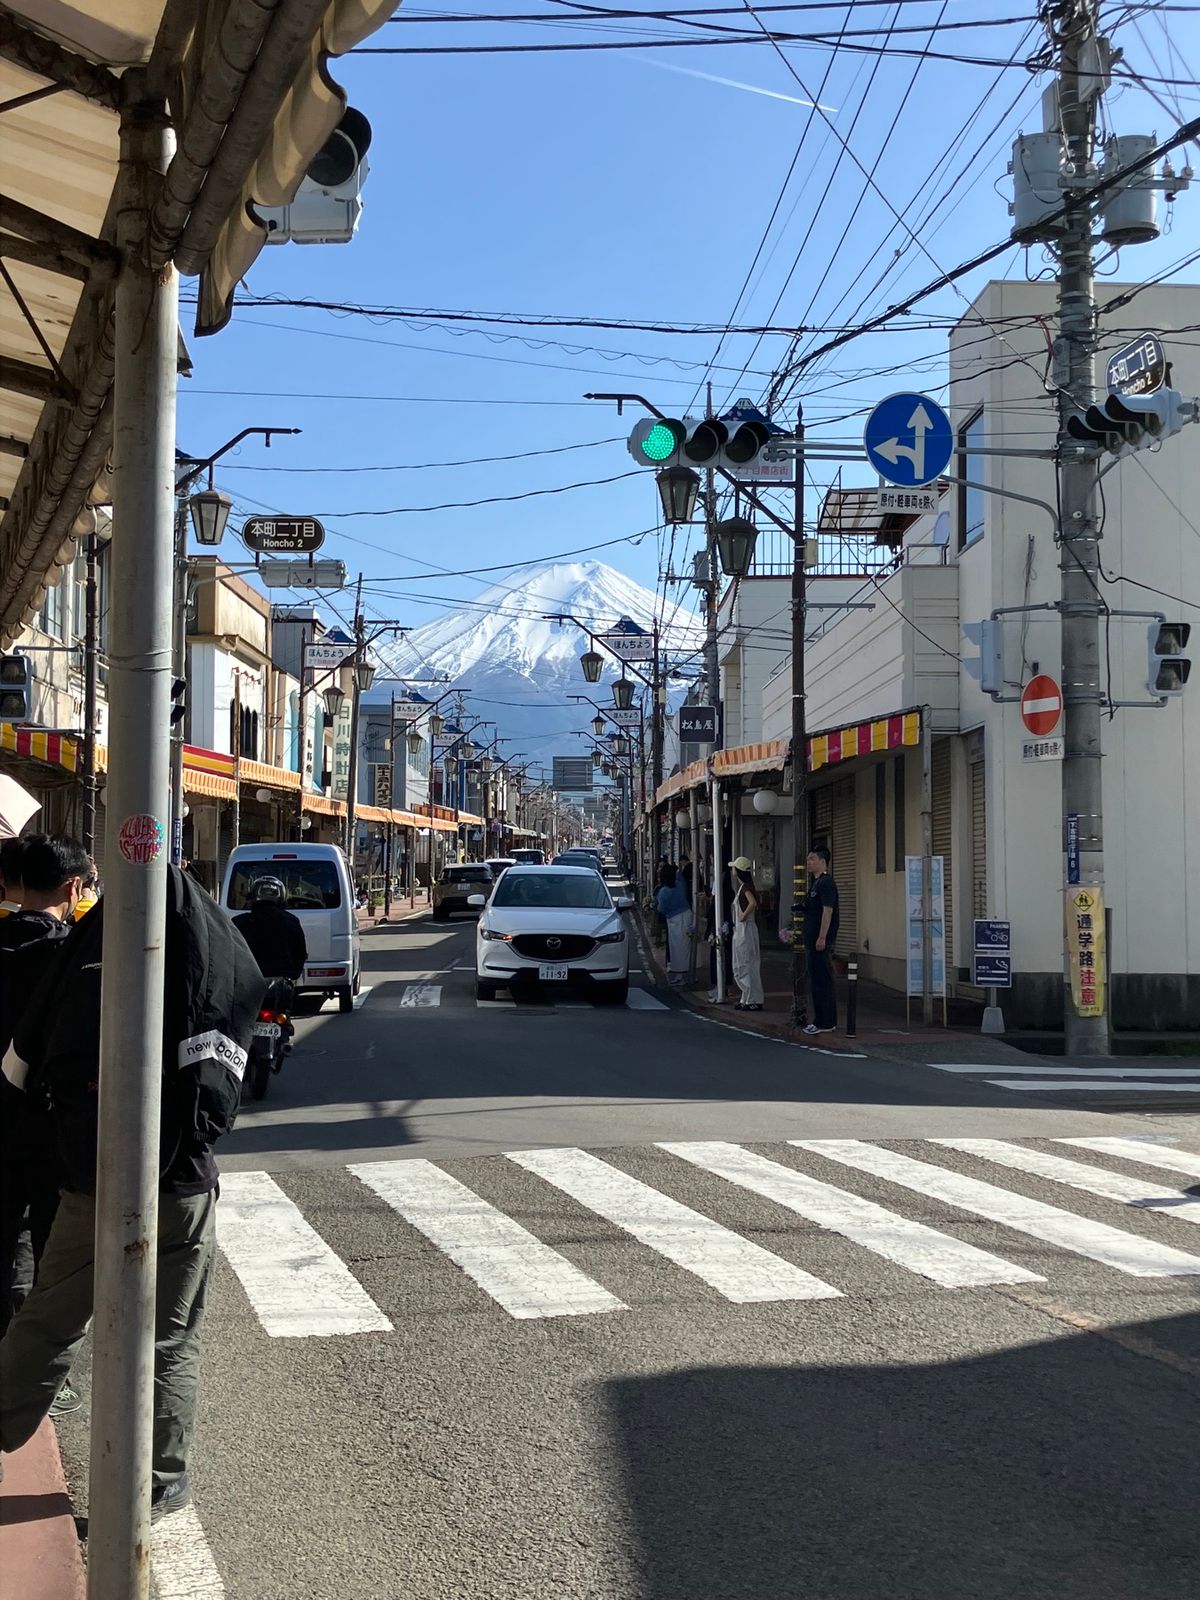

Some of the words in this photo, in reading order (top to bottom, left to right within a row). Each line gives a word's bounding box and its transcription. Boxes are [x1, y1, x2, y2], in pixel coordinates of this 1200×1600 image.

[1109, 340, 1157, 388] 本町二丁目
[1146, 372, 1153, 385] 2
[251, 521, 315, 538] 本町二丁目
[263, 539, 295, 548] Honcho
[297, 539, 303, 548] 2
[681, 719, 714, 730] 松島屋
[1077, 914, 1097, 1005] 通学路注意
[186, 1040, 212, 1056] new
